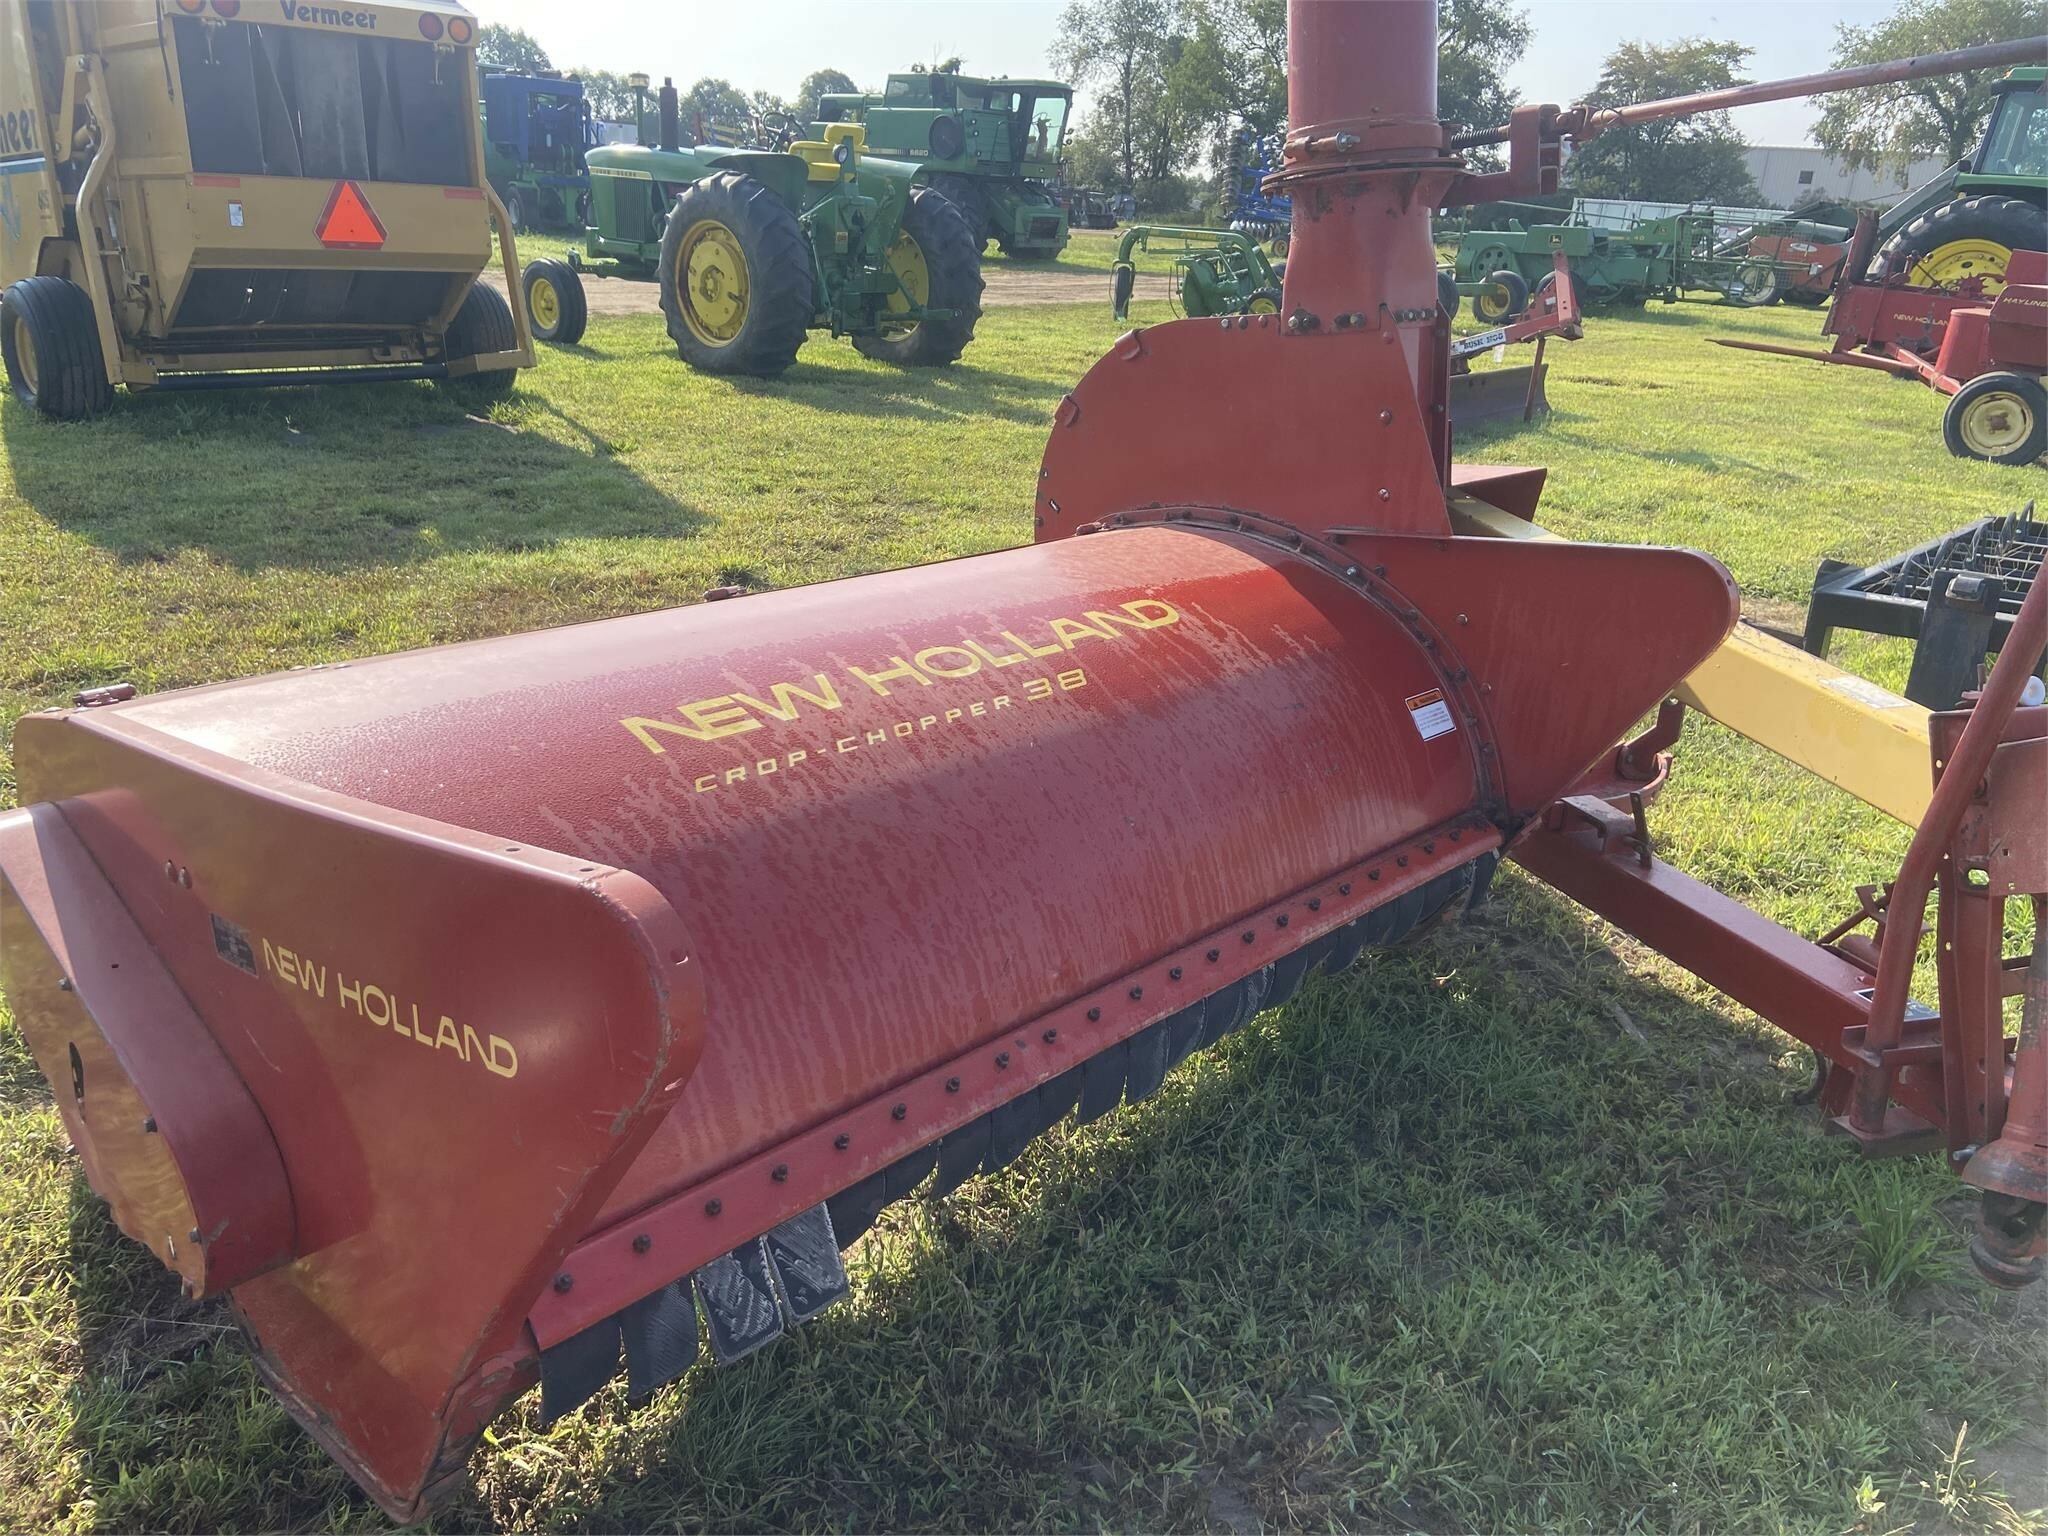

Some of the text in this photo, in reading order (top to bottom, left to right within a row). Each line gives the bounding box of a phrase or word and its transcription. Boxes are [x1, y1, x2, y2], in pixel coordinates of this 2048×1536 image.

[280, 0, 377, 29] Vermeer
[1893, 313, 1949, 326] NEW HOLLAN
[2003, 297, 2048, 308] HAYLINE
[618, 599, 1181, 755] NEW HOLLAND
[694, 668, 1087, 793] CROP-CHOPPER 38
[262, 937, 327, 998] NEW
[337, 972, 519, 1079] HOLLAND
